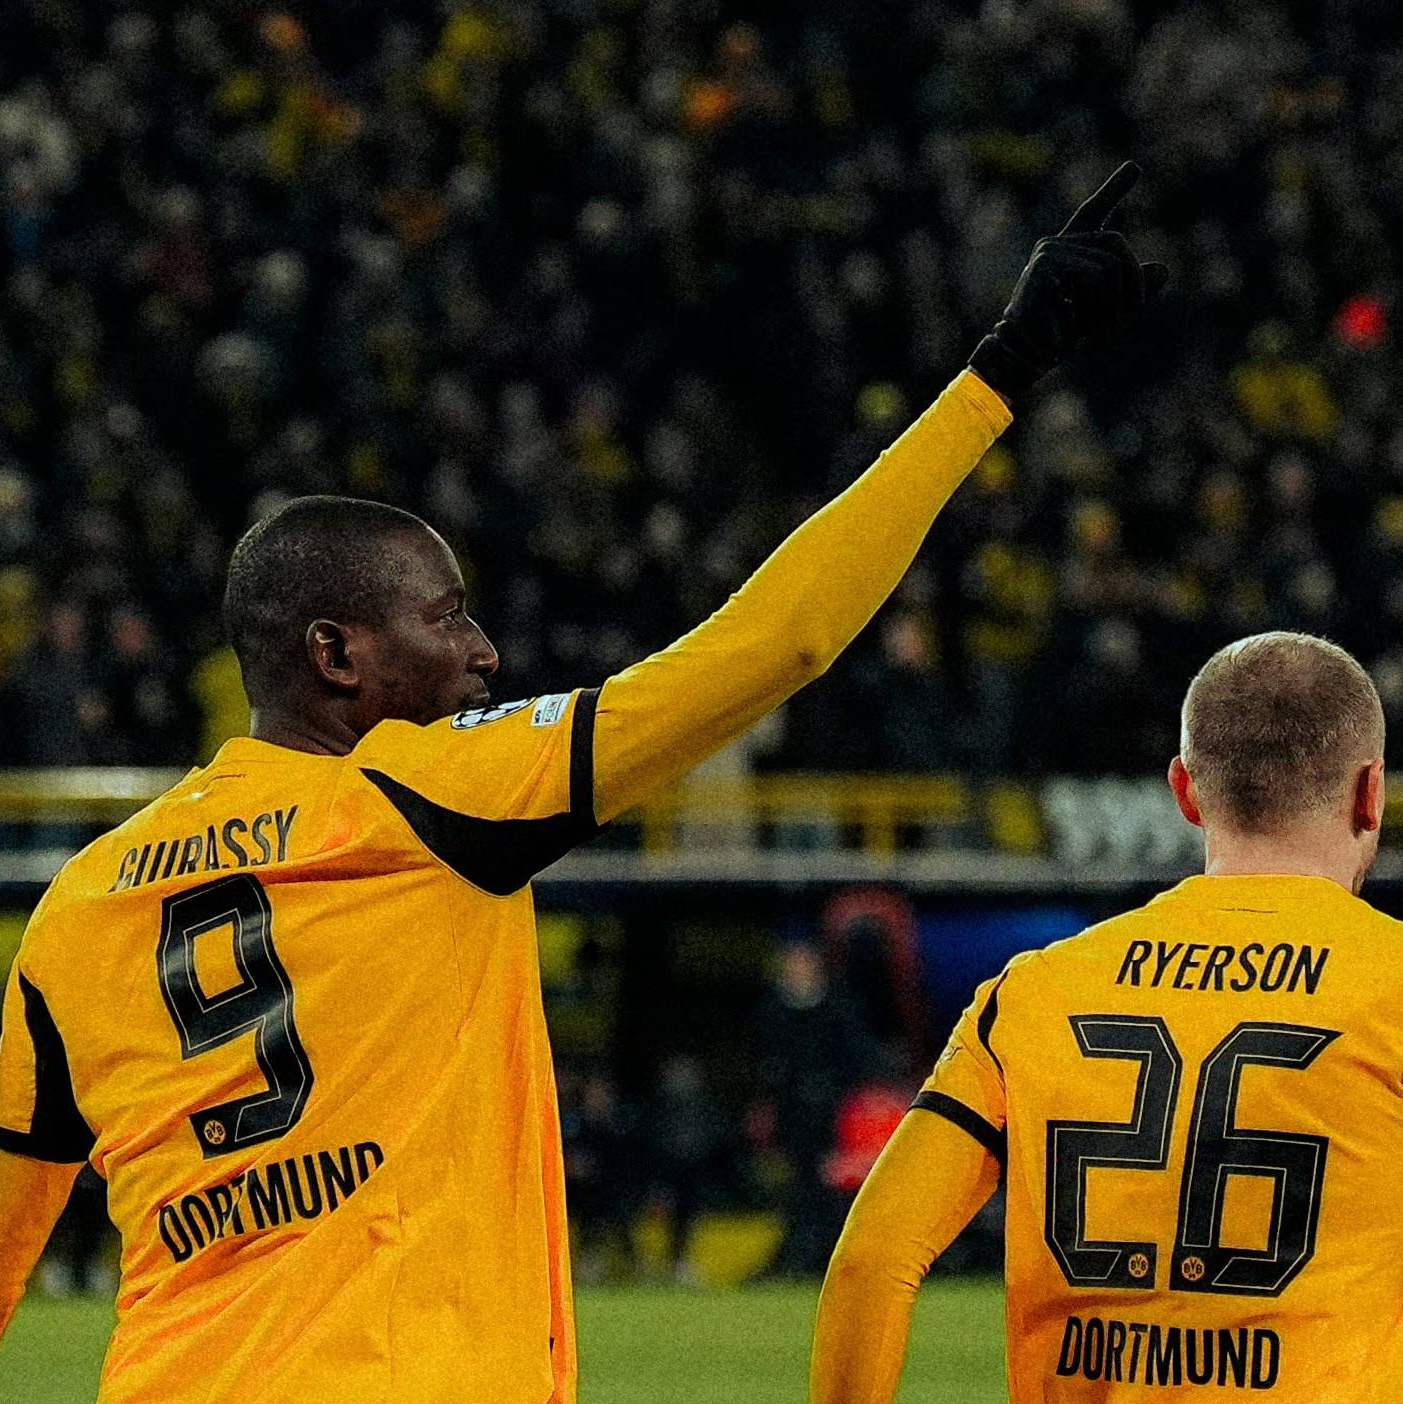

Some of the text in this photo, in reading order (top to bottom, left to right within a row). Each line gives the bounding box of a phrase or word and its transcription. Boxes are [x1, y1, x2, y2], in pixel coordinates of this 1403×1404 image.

[156, 872, 315, 1160] 9
[1115, 940, 1330, 995] RYERSON
[1044, 1014, 1345, 1297] 26
[1055, 1315, 1281, 1391] DORTMUND
